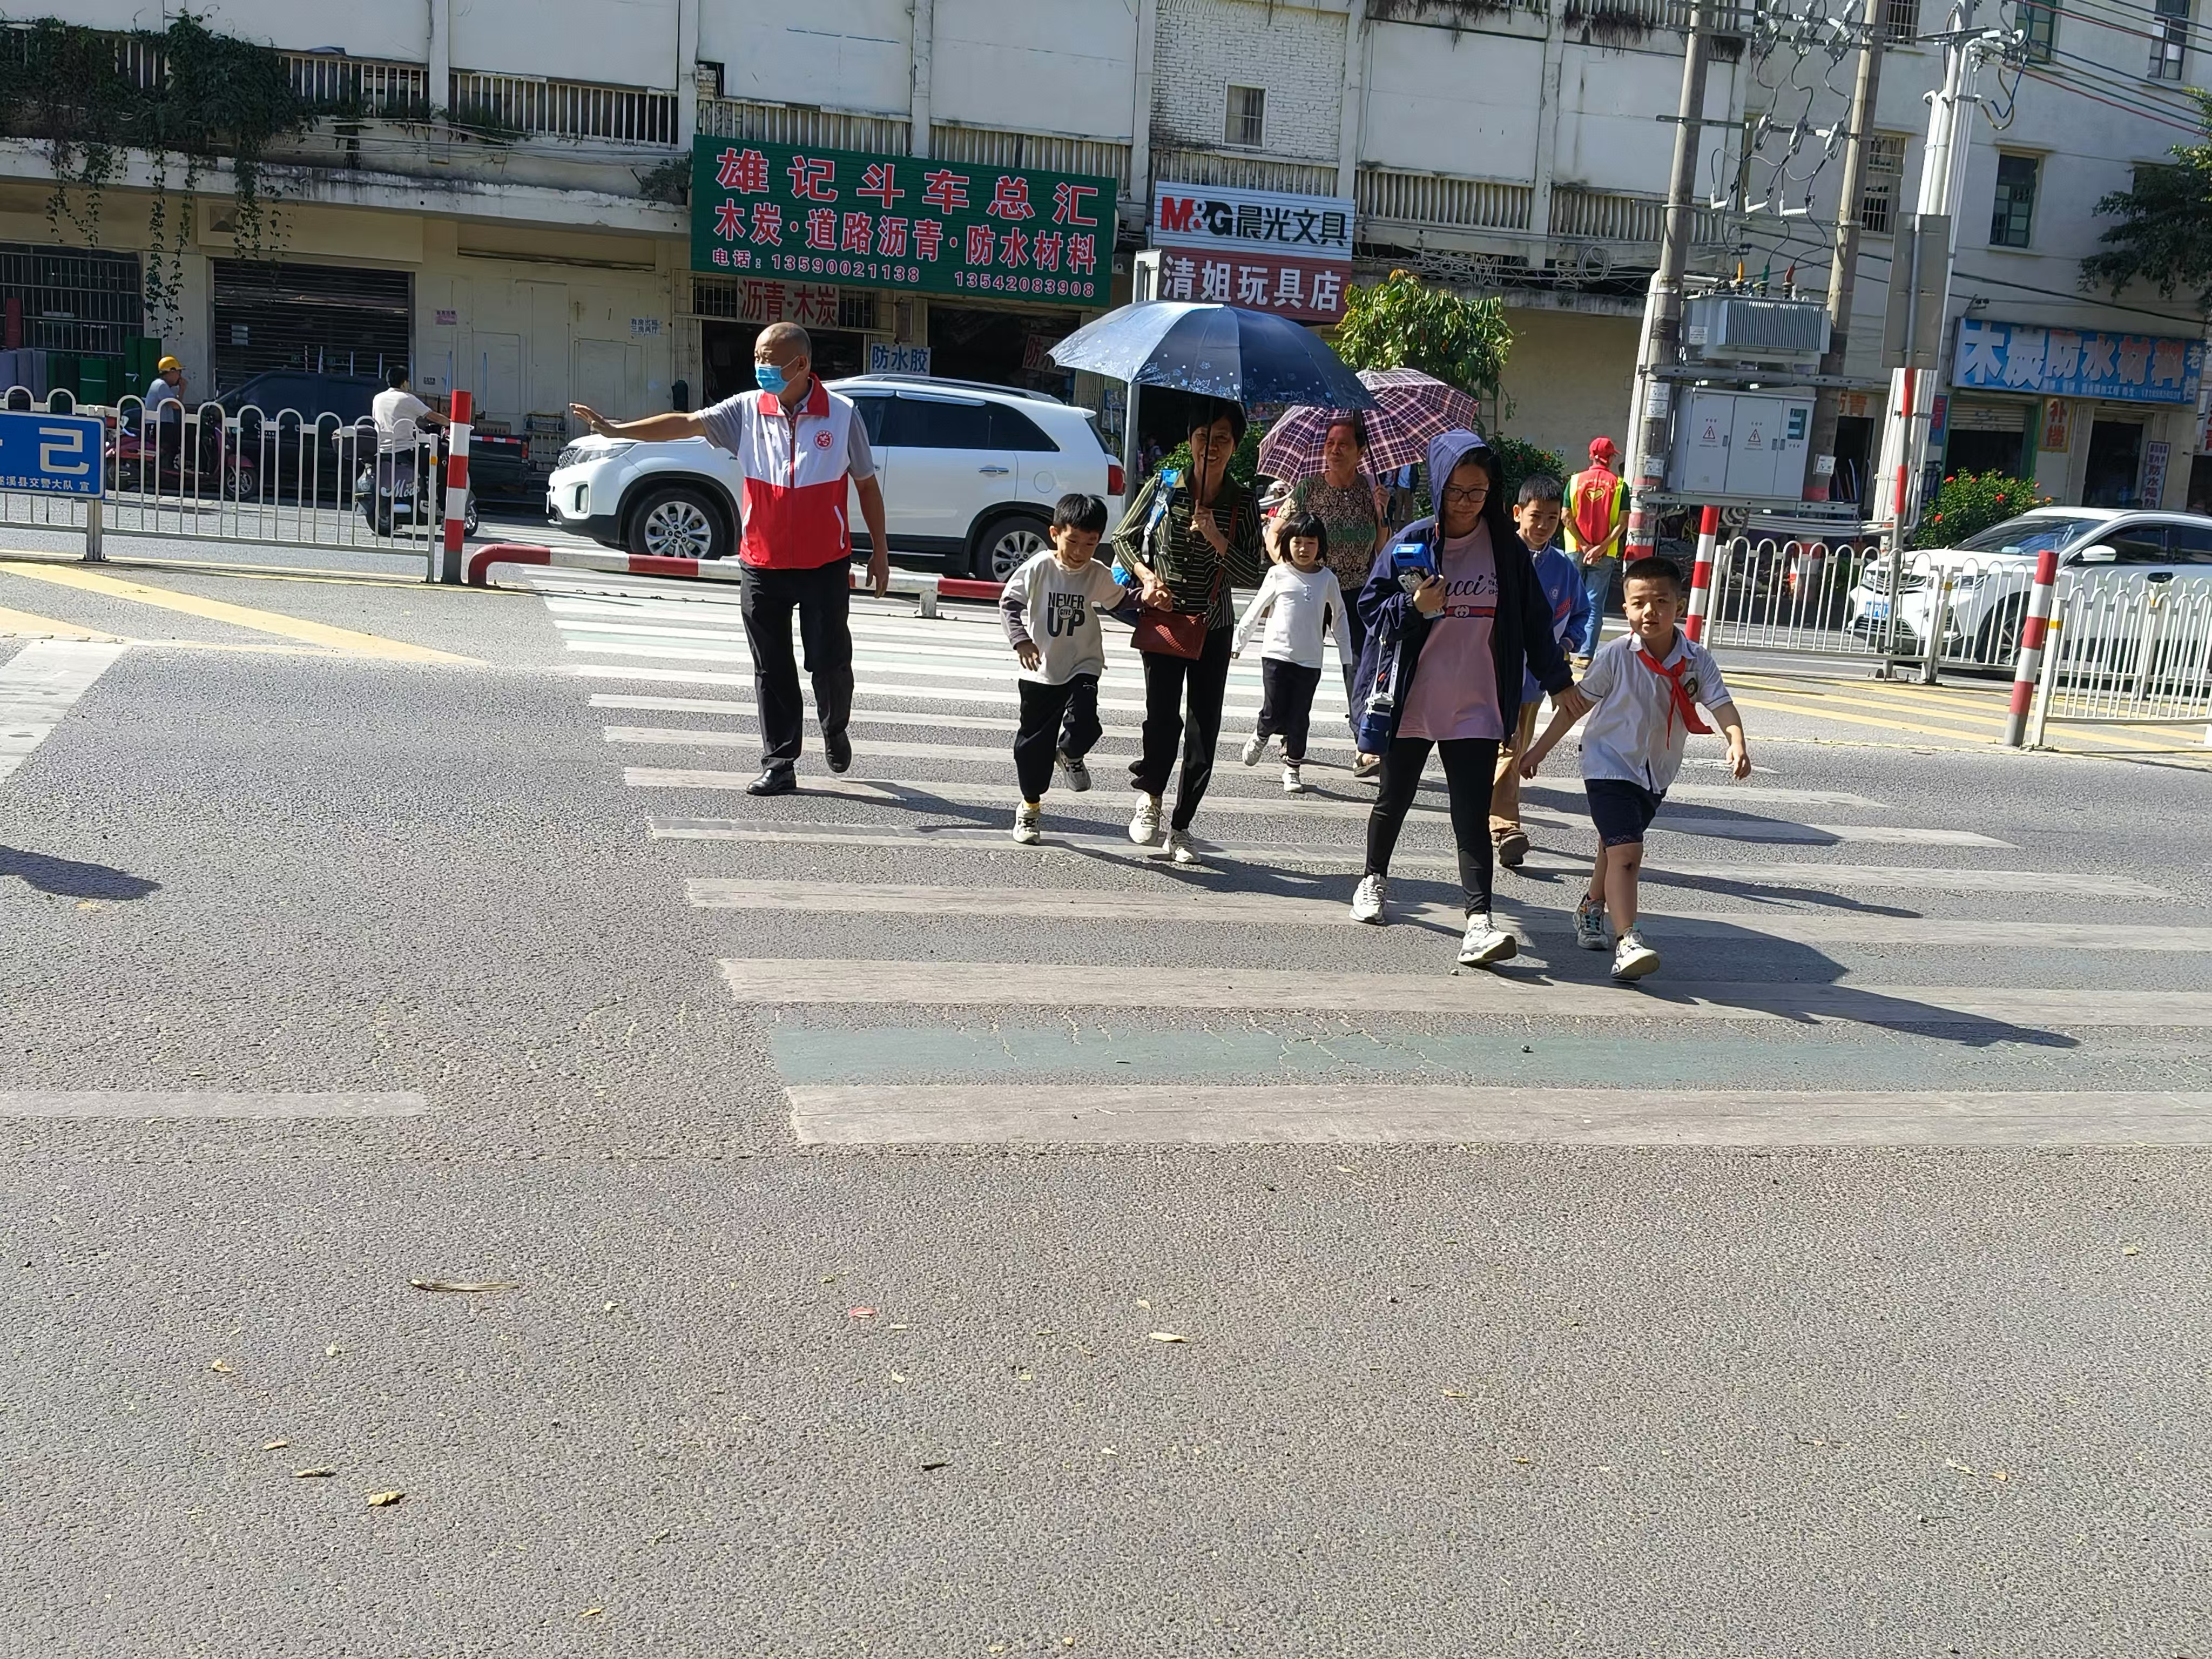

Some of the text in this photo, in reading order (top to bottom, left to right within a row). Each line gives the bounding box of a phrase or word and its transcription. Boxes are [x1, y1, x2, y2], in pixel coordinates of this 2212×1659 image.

[716, 147, 1098, 226] 雄记斗车总汇
[1161, 197, 1347, 246] M&G 晨光文具
[772, 254, 919, 282] 13590021138
[954, 272, 1094, 298] 13542083908
[1163, 255, 1341, 311] 清姐玩具店
[872, 345, 928, 373] 防水胶
[1047, 607, 1085, 637] UP
[1048, 591, 1085, 609] NEVER
